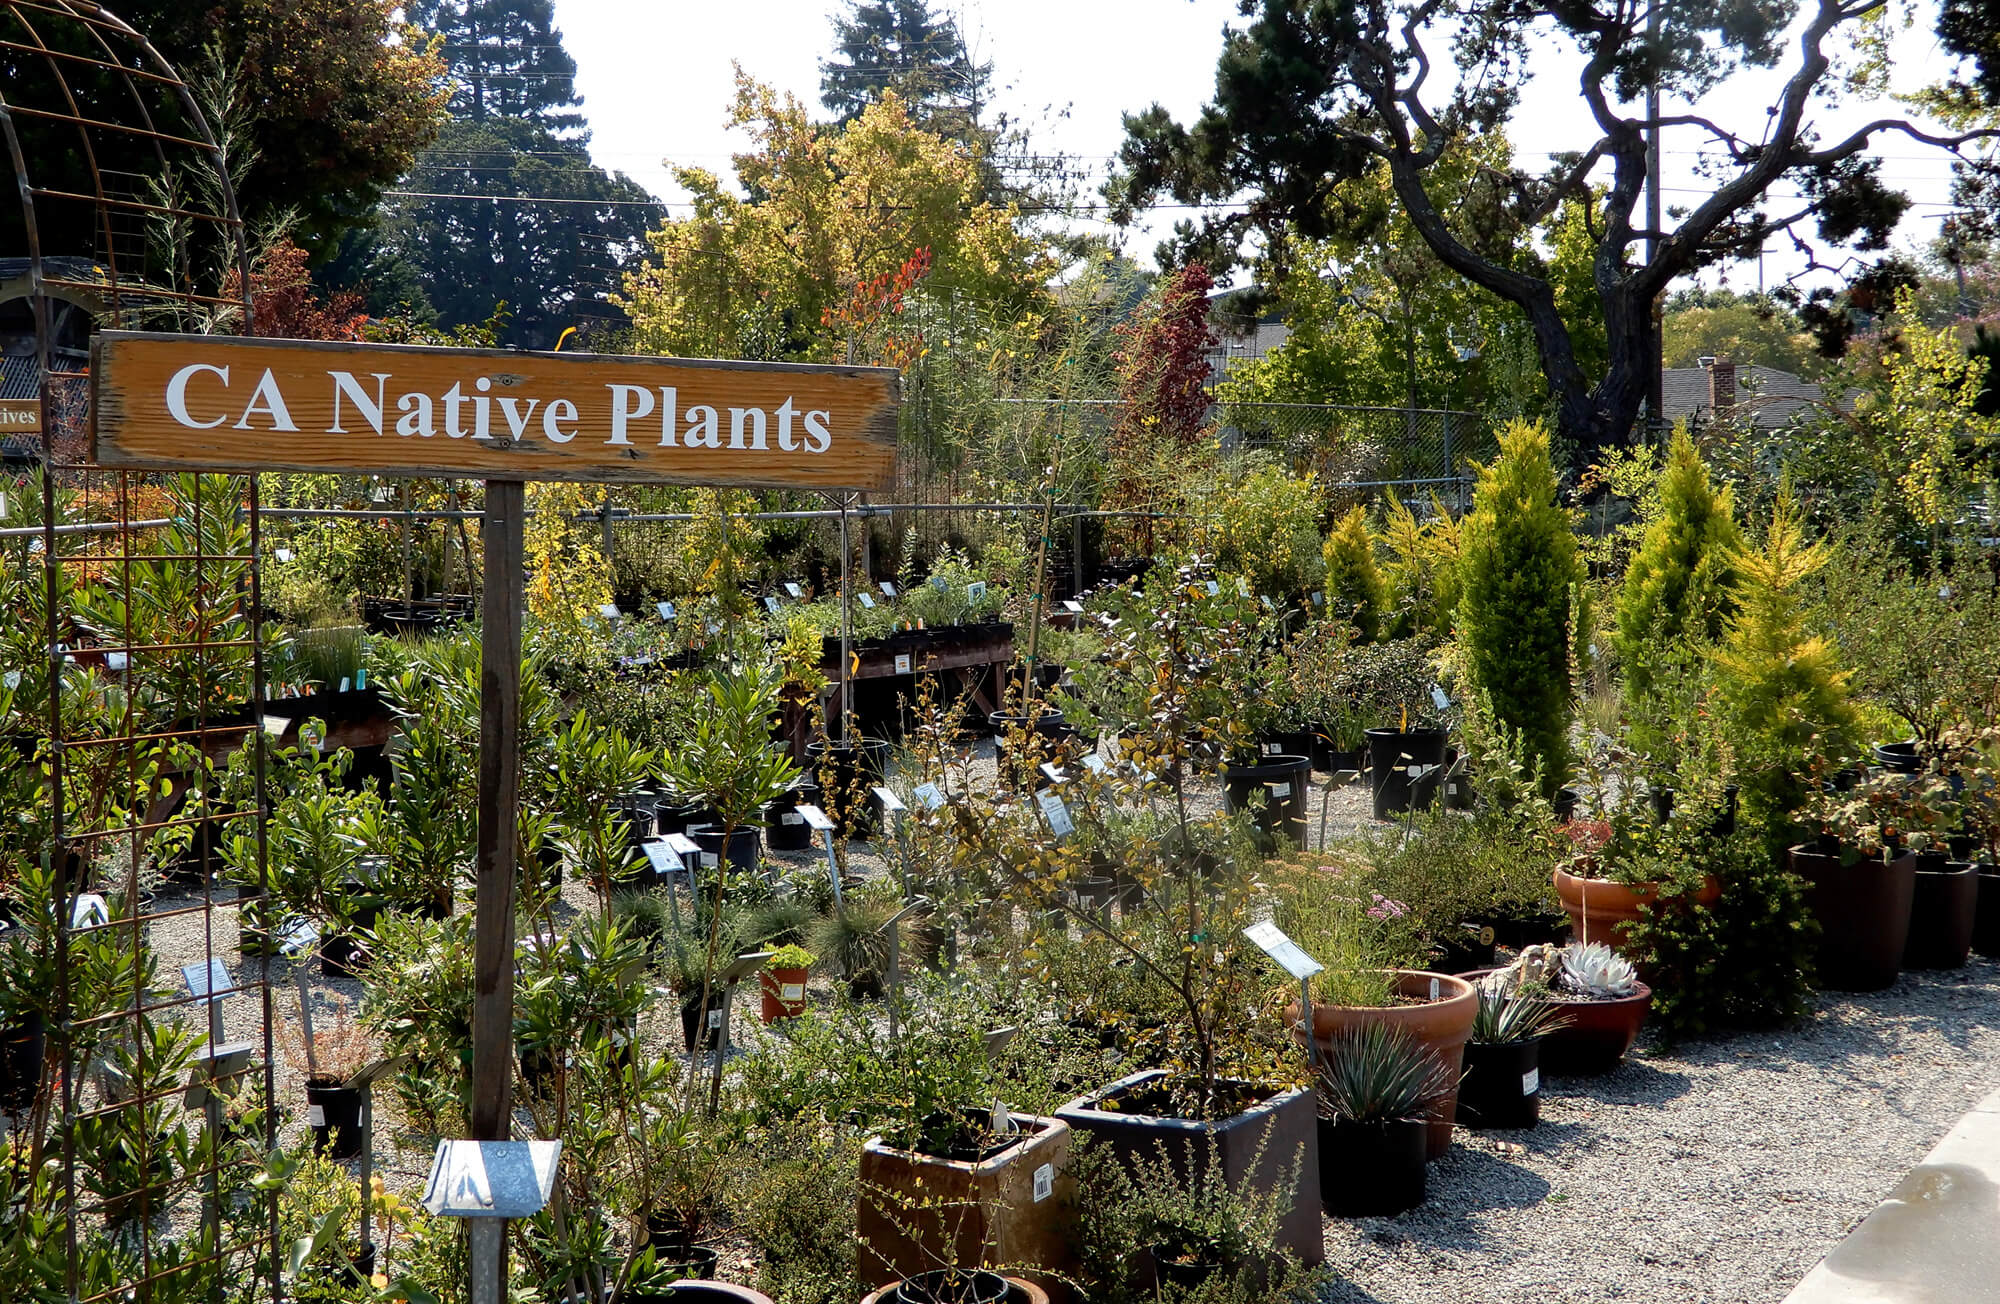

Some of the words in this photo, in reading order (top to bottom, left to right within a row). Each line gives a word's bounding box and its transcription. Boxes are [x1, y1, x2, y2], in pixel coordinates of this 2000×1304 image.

[165, 363, 300, 432] CA
[325, 371, 580, 444] Native
[603, 383, 832, 454] Plants
